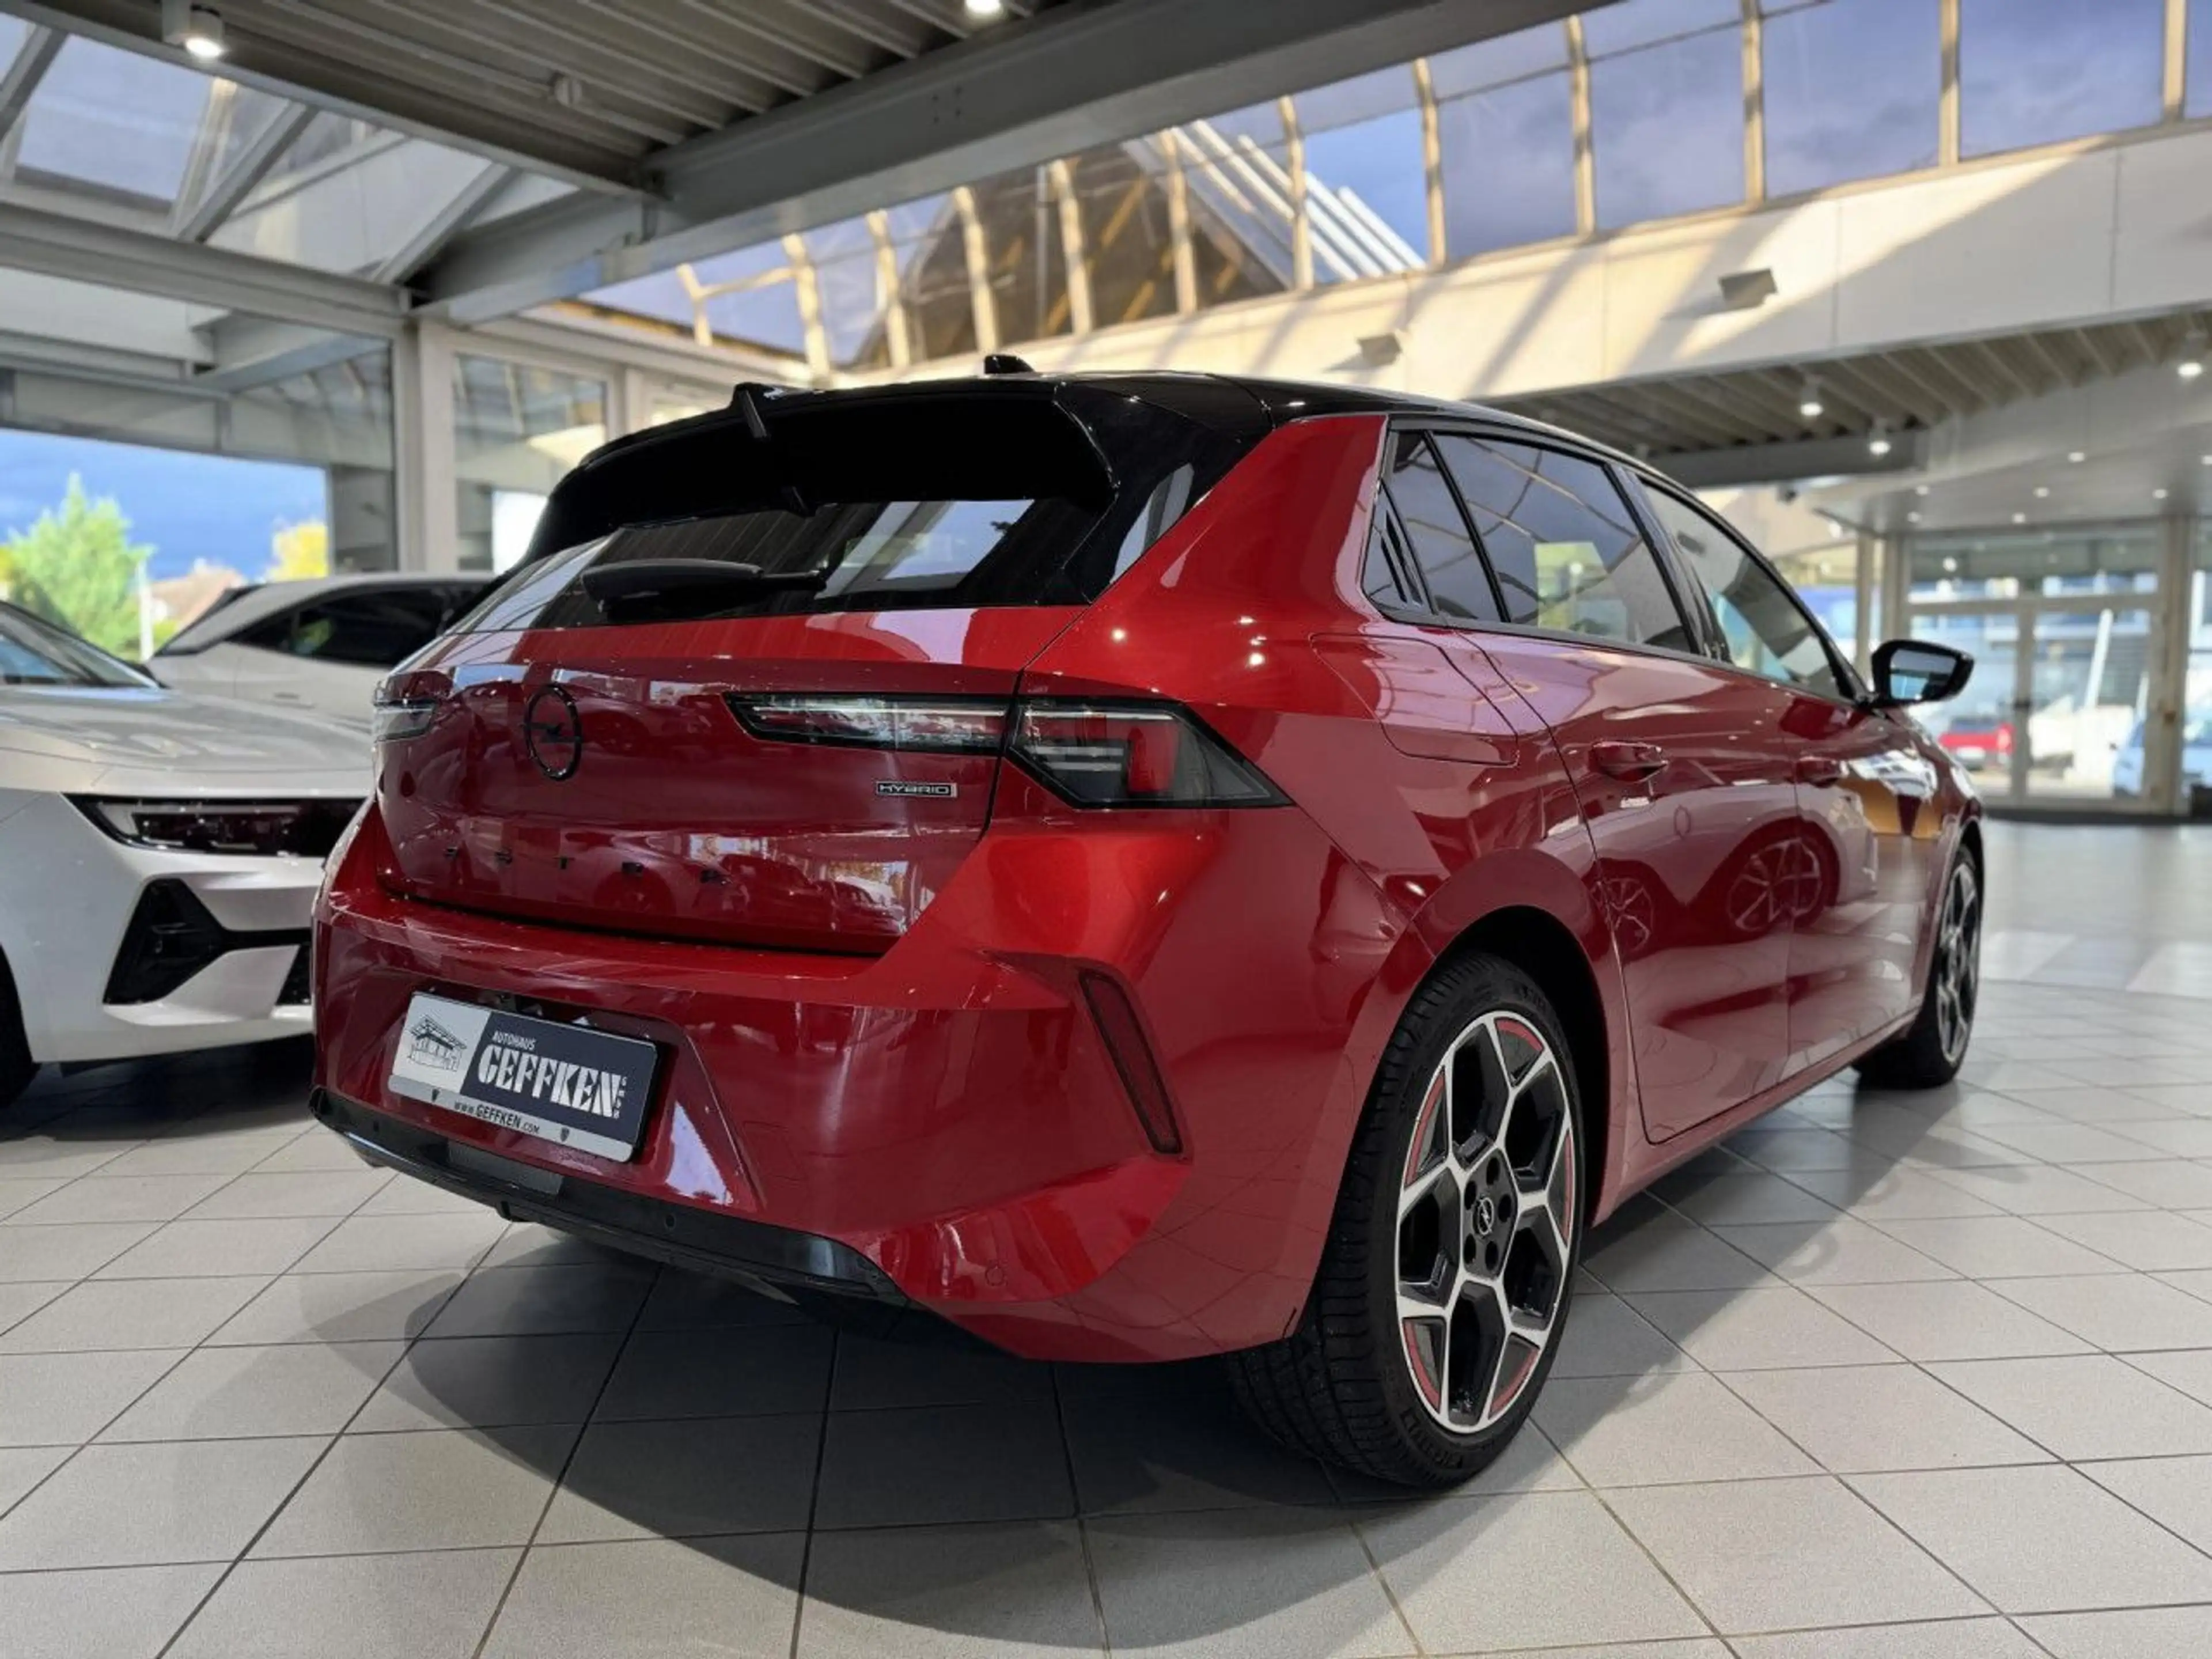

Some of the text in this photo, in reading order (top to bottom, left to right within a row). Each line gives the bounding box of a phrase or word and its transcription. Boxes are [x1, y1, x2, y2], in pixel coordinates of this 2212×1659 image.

[878, 783, 951, 795] HYBRID
[492, 1030, 536, 1050] AUTOHAUS
[478, 1044, 620, 1118] GEFFKEN
